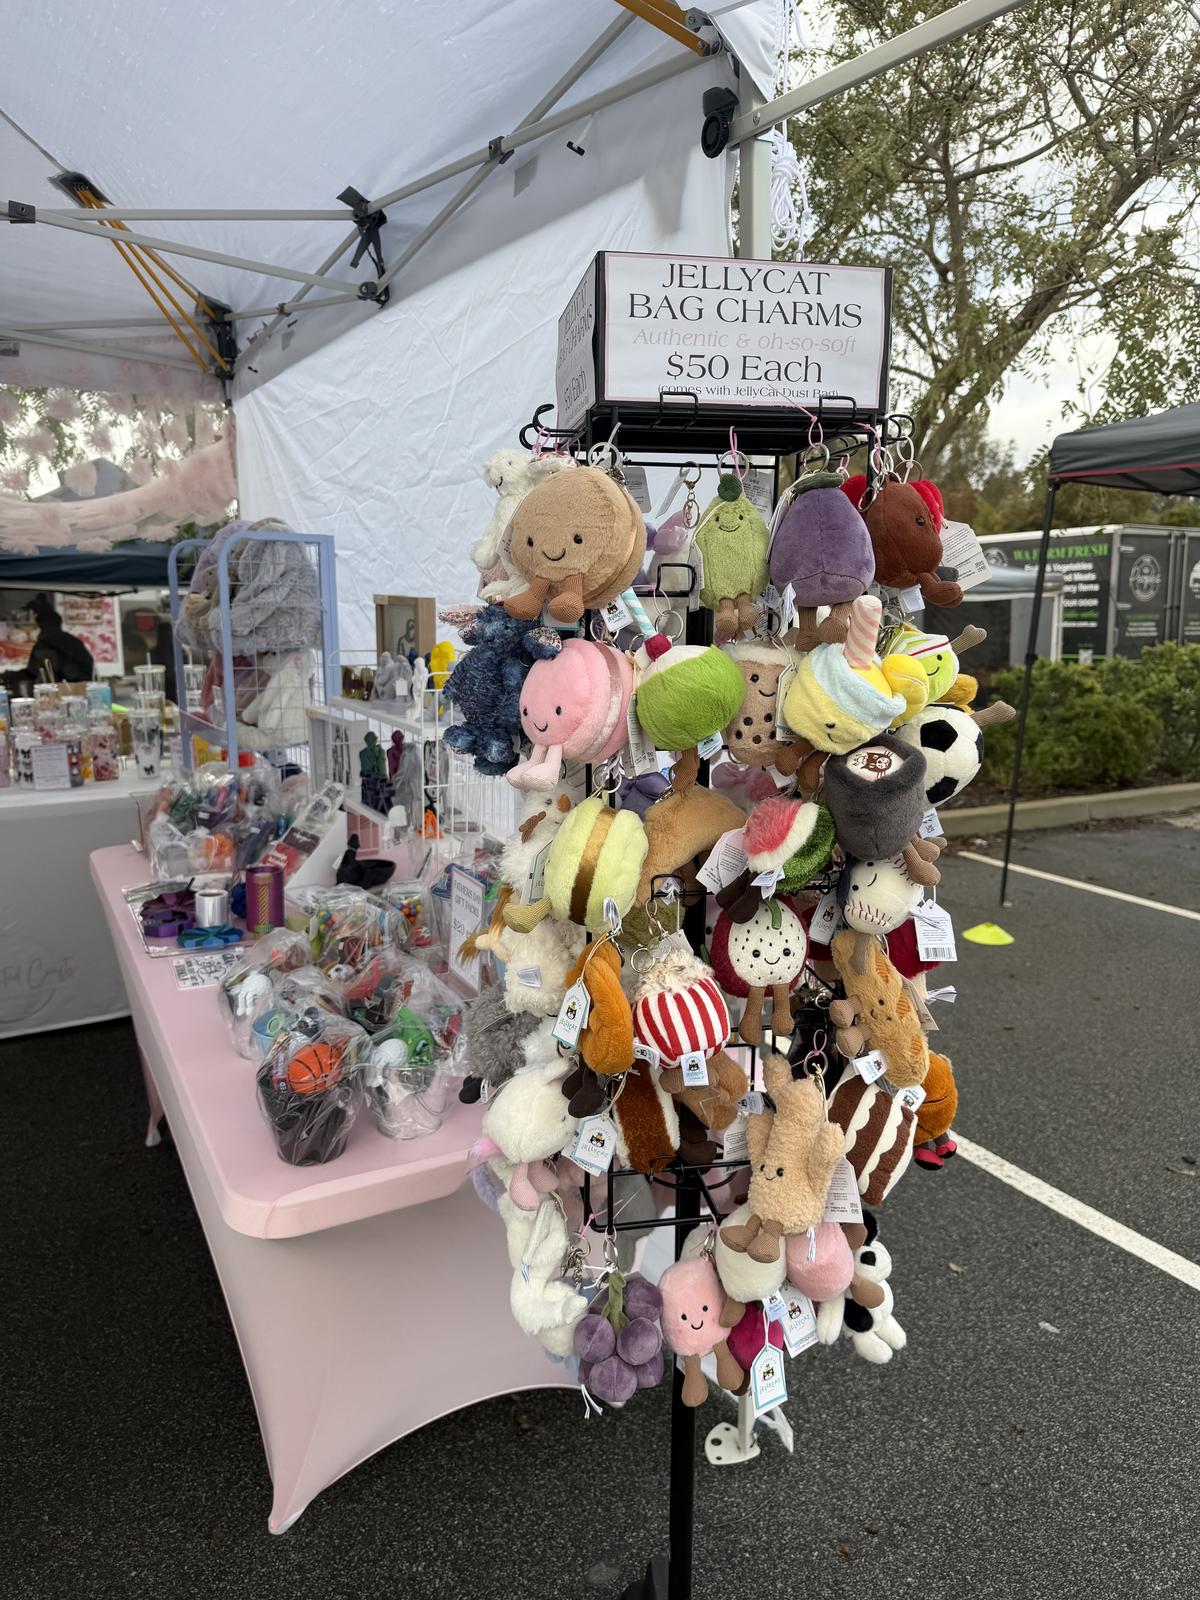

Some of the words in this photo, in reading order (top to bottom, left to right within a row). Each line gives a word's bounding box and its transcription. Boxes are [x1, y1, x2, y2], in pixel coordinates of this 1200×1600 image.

[662, 263, 831, 295] JELLYCAT
[628, 293, 705, 322] BAG
[716, 298, 863, 328] CHARMS
[632, 327, 730, 348] Authentic
[736, 331, 751, 348] &
[757, 332, 858, 357] oh-so-soft
[666, 351, 730, 381] $50
[741, 355, 823, 383] Each
[705, 384, 731, 396] with
[782, 388, 810, 398] Dust
[1067, 543, 1109, 558] FRESH
